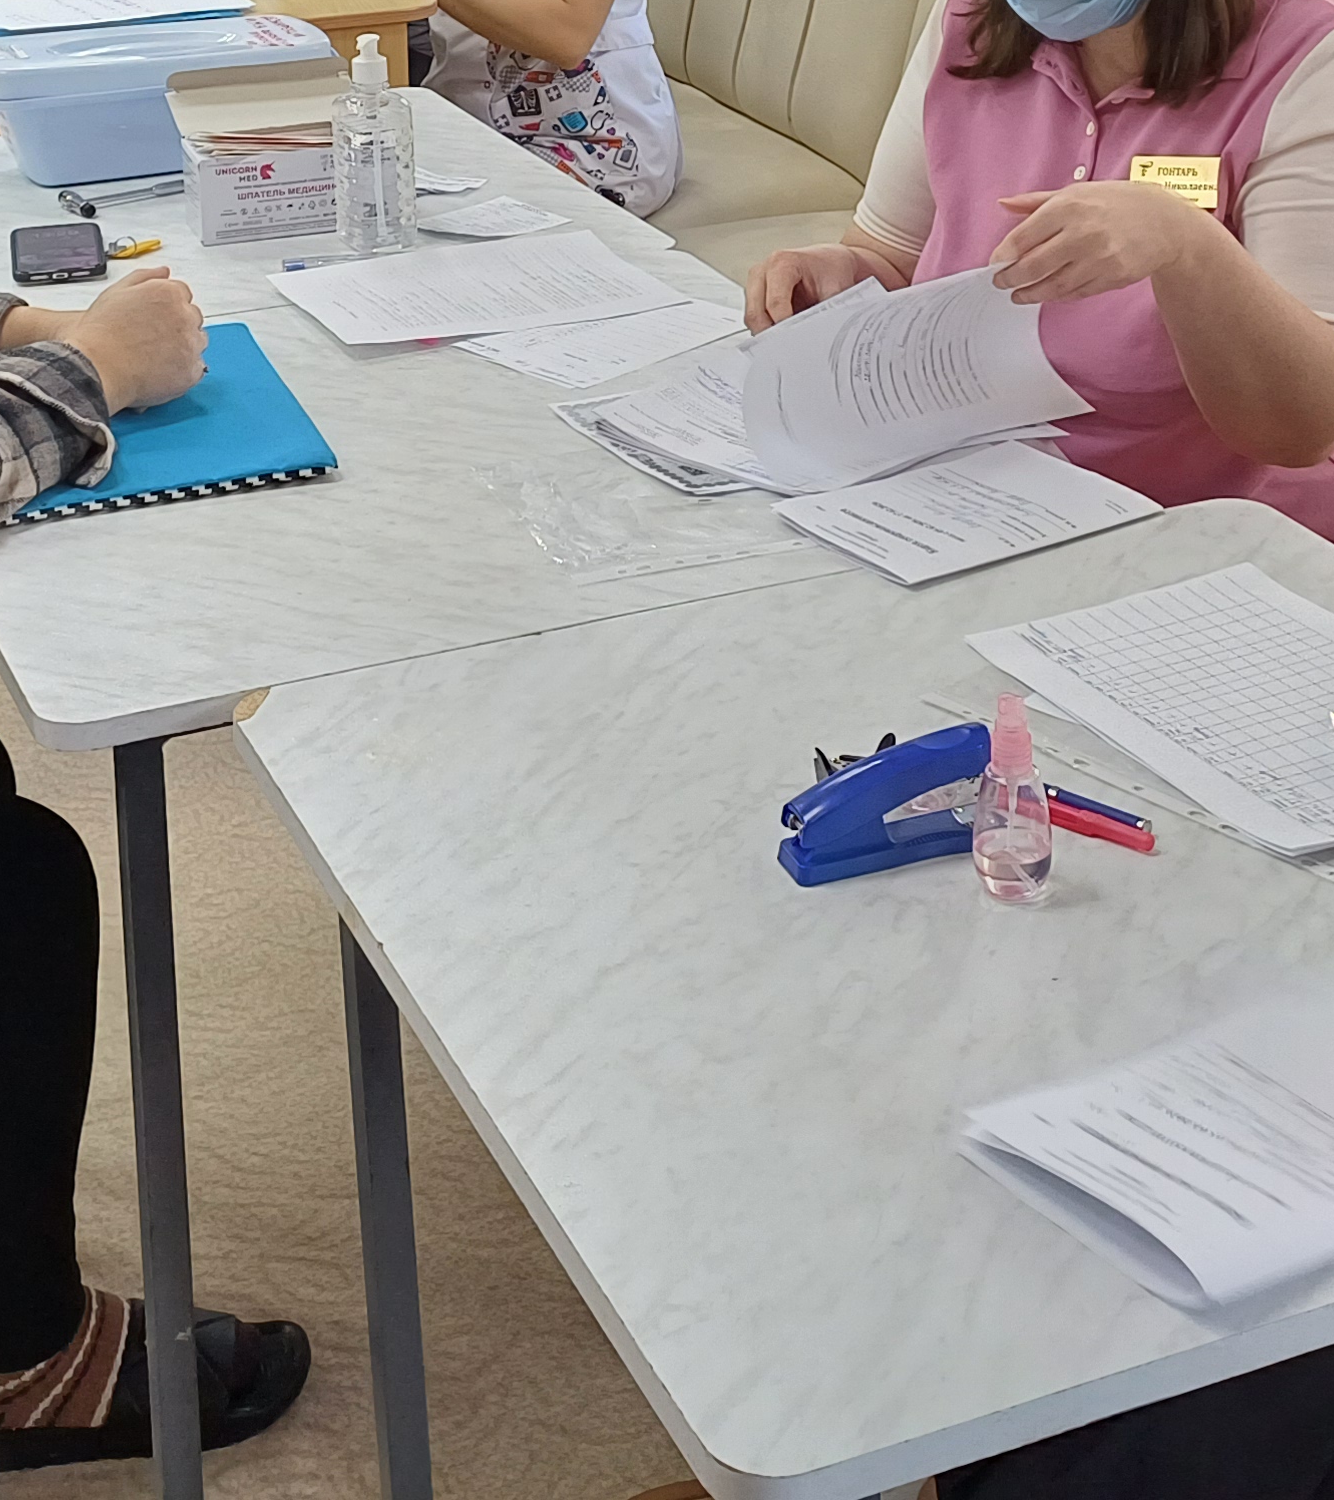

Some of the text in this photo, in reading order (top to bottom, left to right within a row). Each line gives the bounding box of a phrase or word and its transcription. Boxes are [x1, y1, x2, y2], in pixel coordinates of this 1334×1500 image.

[215, 165, 258, 176] UNICORN
[1157, 166, 1198, 177] ГОНТАРЬ
[238, 174, 258, 183] MED
[237, 190, 285, 201] ШПАТЕЛЬ
